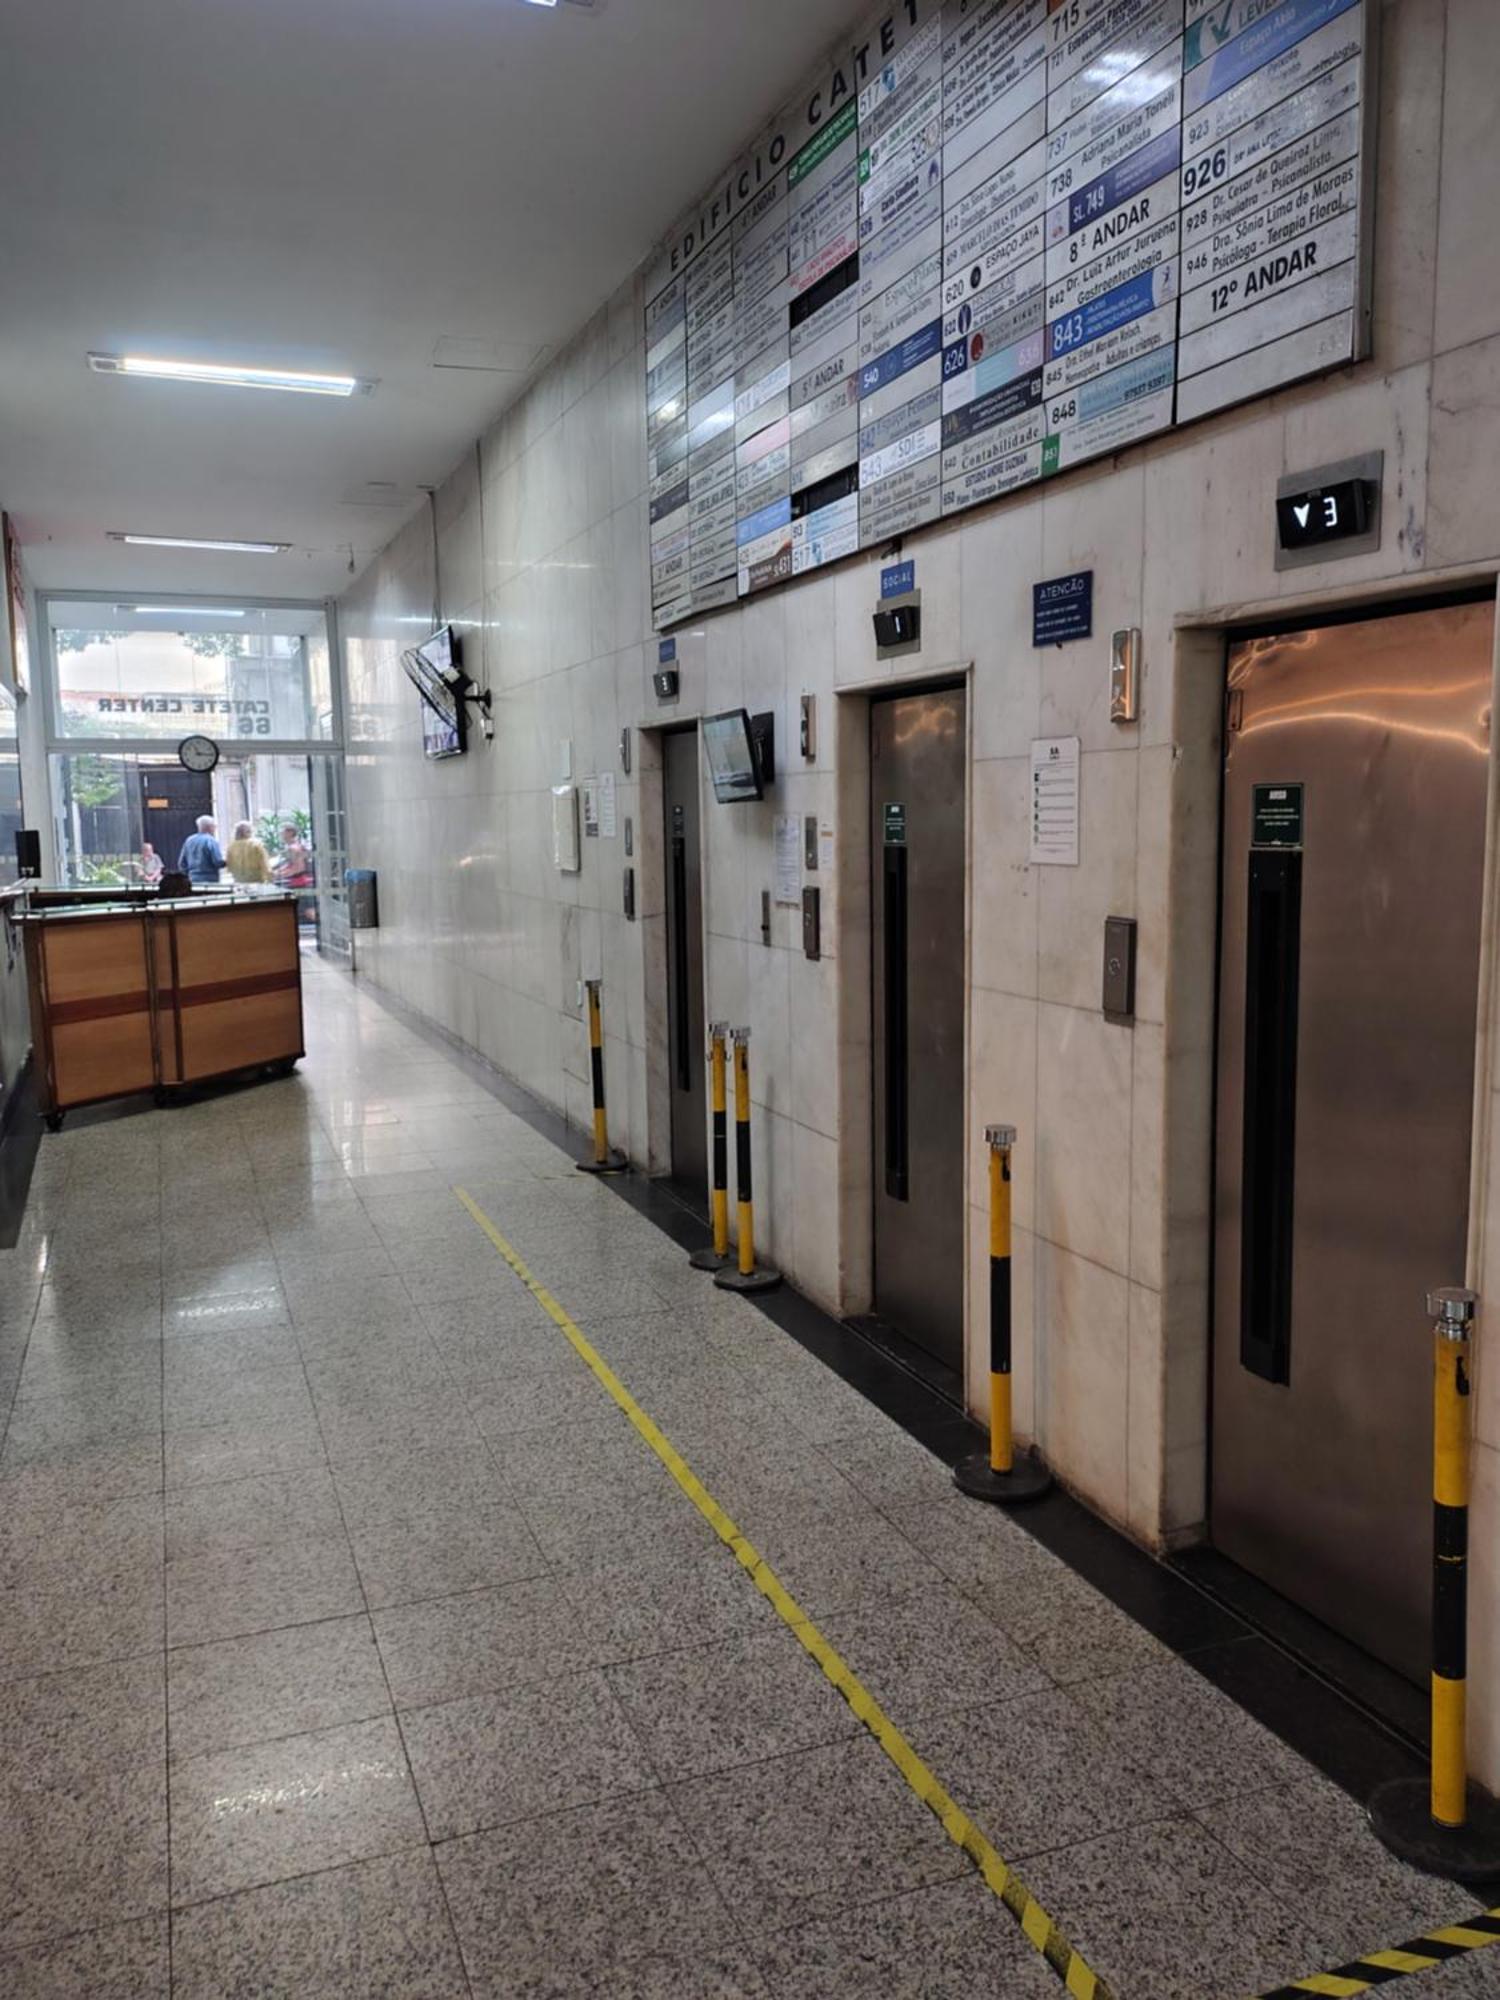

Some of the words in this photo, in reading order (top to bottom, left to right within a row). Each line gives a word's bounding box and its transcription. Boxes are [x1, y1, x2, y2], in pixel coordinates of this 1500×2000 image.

[1117, 116, 1142, 140] Maria
[1189, 120, 1209, 144] 923
[1048, 131, 1068, 159] 737
[1184, 148, 1226, 196] 926
[1255, 167, 1267, 184] de
[1270, 142, 1309, 175] Queiroz
[1051, 168, 1072, 197] 738
[1235, 215, 1263, 241] Sônia
[1266, 202, 1293, 223] Lima
[1295, 192, 1309, 208] de
[1311, 168, 1354, 201] Moraes
[1092, 198, 1150, 250] ANDAR
[1186, 209, 1208, 232] 928
[1267, 214, 1306, 244] Terapia
[985, 238, 1017, 269] ESPAÇO
[1083, 262, 1103, 282] Luiz
[1105, 246, 1131, 271] Artur
[1187, 254, 1208, 275] 946
[1077, 250, 1162, 304] Gastroenterologia
[1244, 241, 1317, 298] ANDAR
[946, 279, 964, 304] 620
[1053, 314, 1083, 351] 843
[944, 345, 964, 374] 626
[1052, 400, 1076, 424] 848
[961, 427, 1039, 470] Contabilidade
[1323, 496, 1338, 527] 3
[883, 571, 912, 590] SOCIAL
